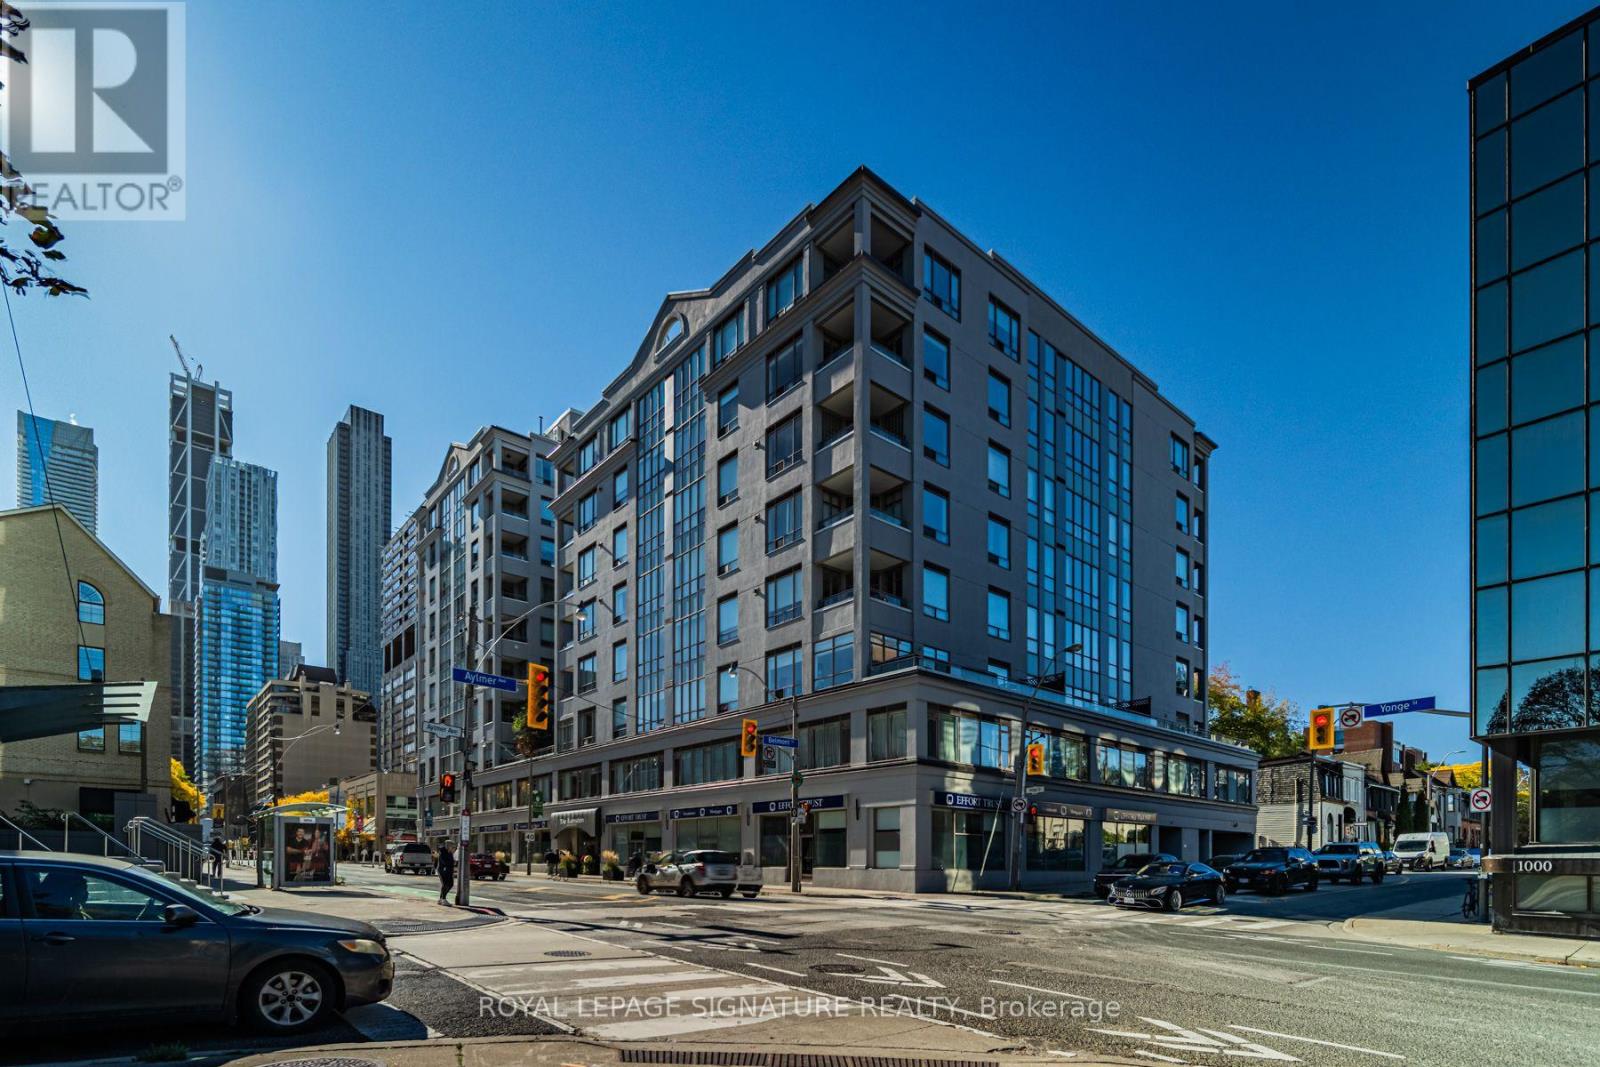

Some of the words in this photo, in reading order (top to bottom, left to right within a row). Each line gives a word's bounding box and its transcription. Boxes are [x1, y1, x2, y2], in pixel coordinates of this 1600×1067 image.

[465, 671, 497, 685] Aylmer
[1380, 702, 1410, 713] Yonge
[956, 795, 981, 806] EFFORT
[1518, 860, 1553, 872] 1000
